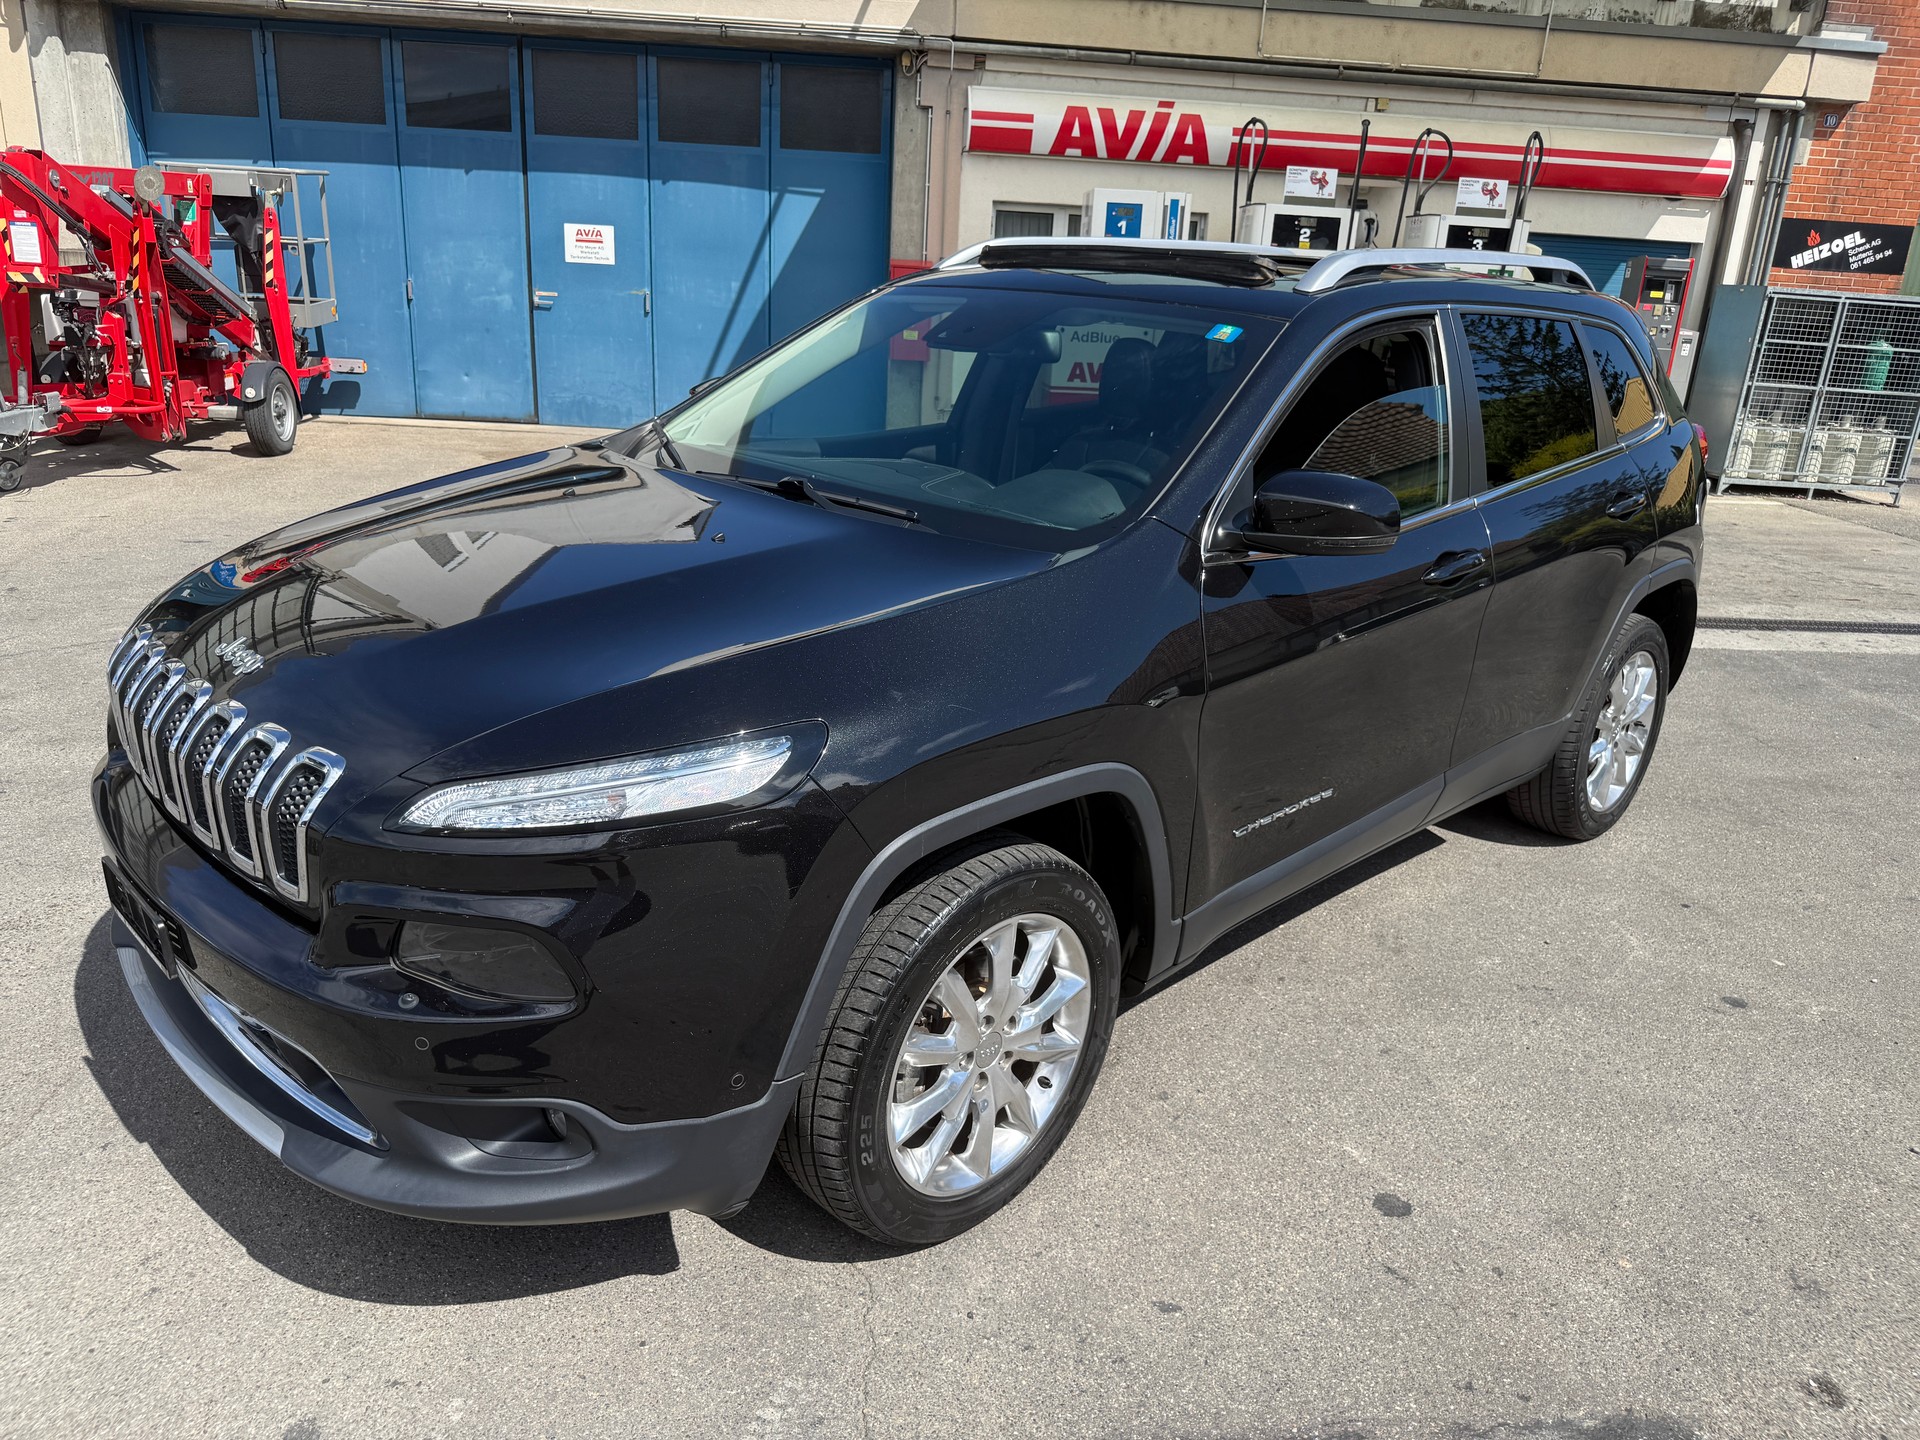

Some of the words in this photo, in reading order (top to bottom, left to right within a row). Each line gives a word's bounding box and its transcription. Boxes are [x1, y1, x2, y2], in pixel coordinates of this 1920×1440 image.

[1826, 115, 1836, 126] 10
[1117, 220, 1127, 235] 1
[1299, 228, 1311, 242] 2
[1471, 239, 1483, 250] 3
[1790, 231, 1866, 269] HEIZOEL
[1848, 244, 1871, 256] Schenk
[1871, 238, 1882, 247] AG
[1848, 249, 1874, 264] Muttenz
[1875, 252, 1884, 261] 94
[1884, 248, 1893, 257] 94
[1070, 331, 1120, 344] AdBlue
[1067, 361, 1104, 384] AV
[215, 636, 265, 676] Jeep
[1233, 788, 1334, 838] CHEROKEE
[1058, 882, 1115, 948] ROADX
[860, 1114, 874, 1167] 225
